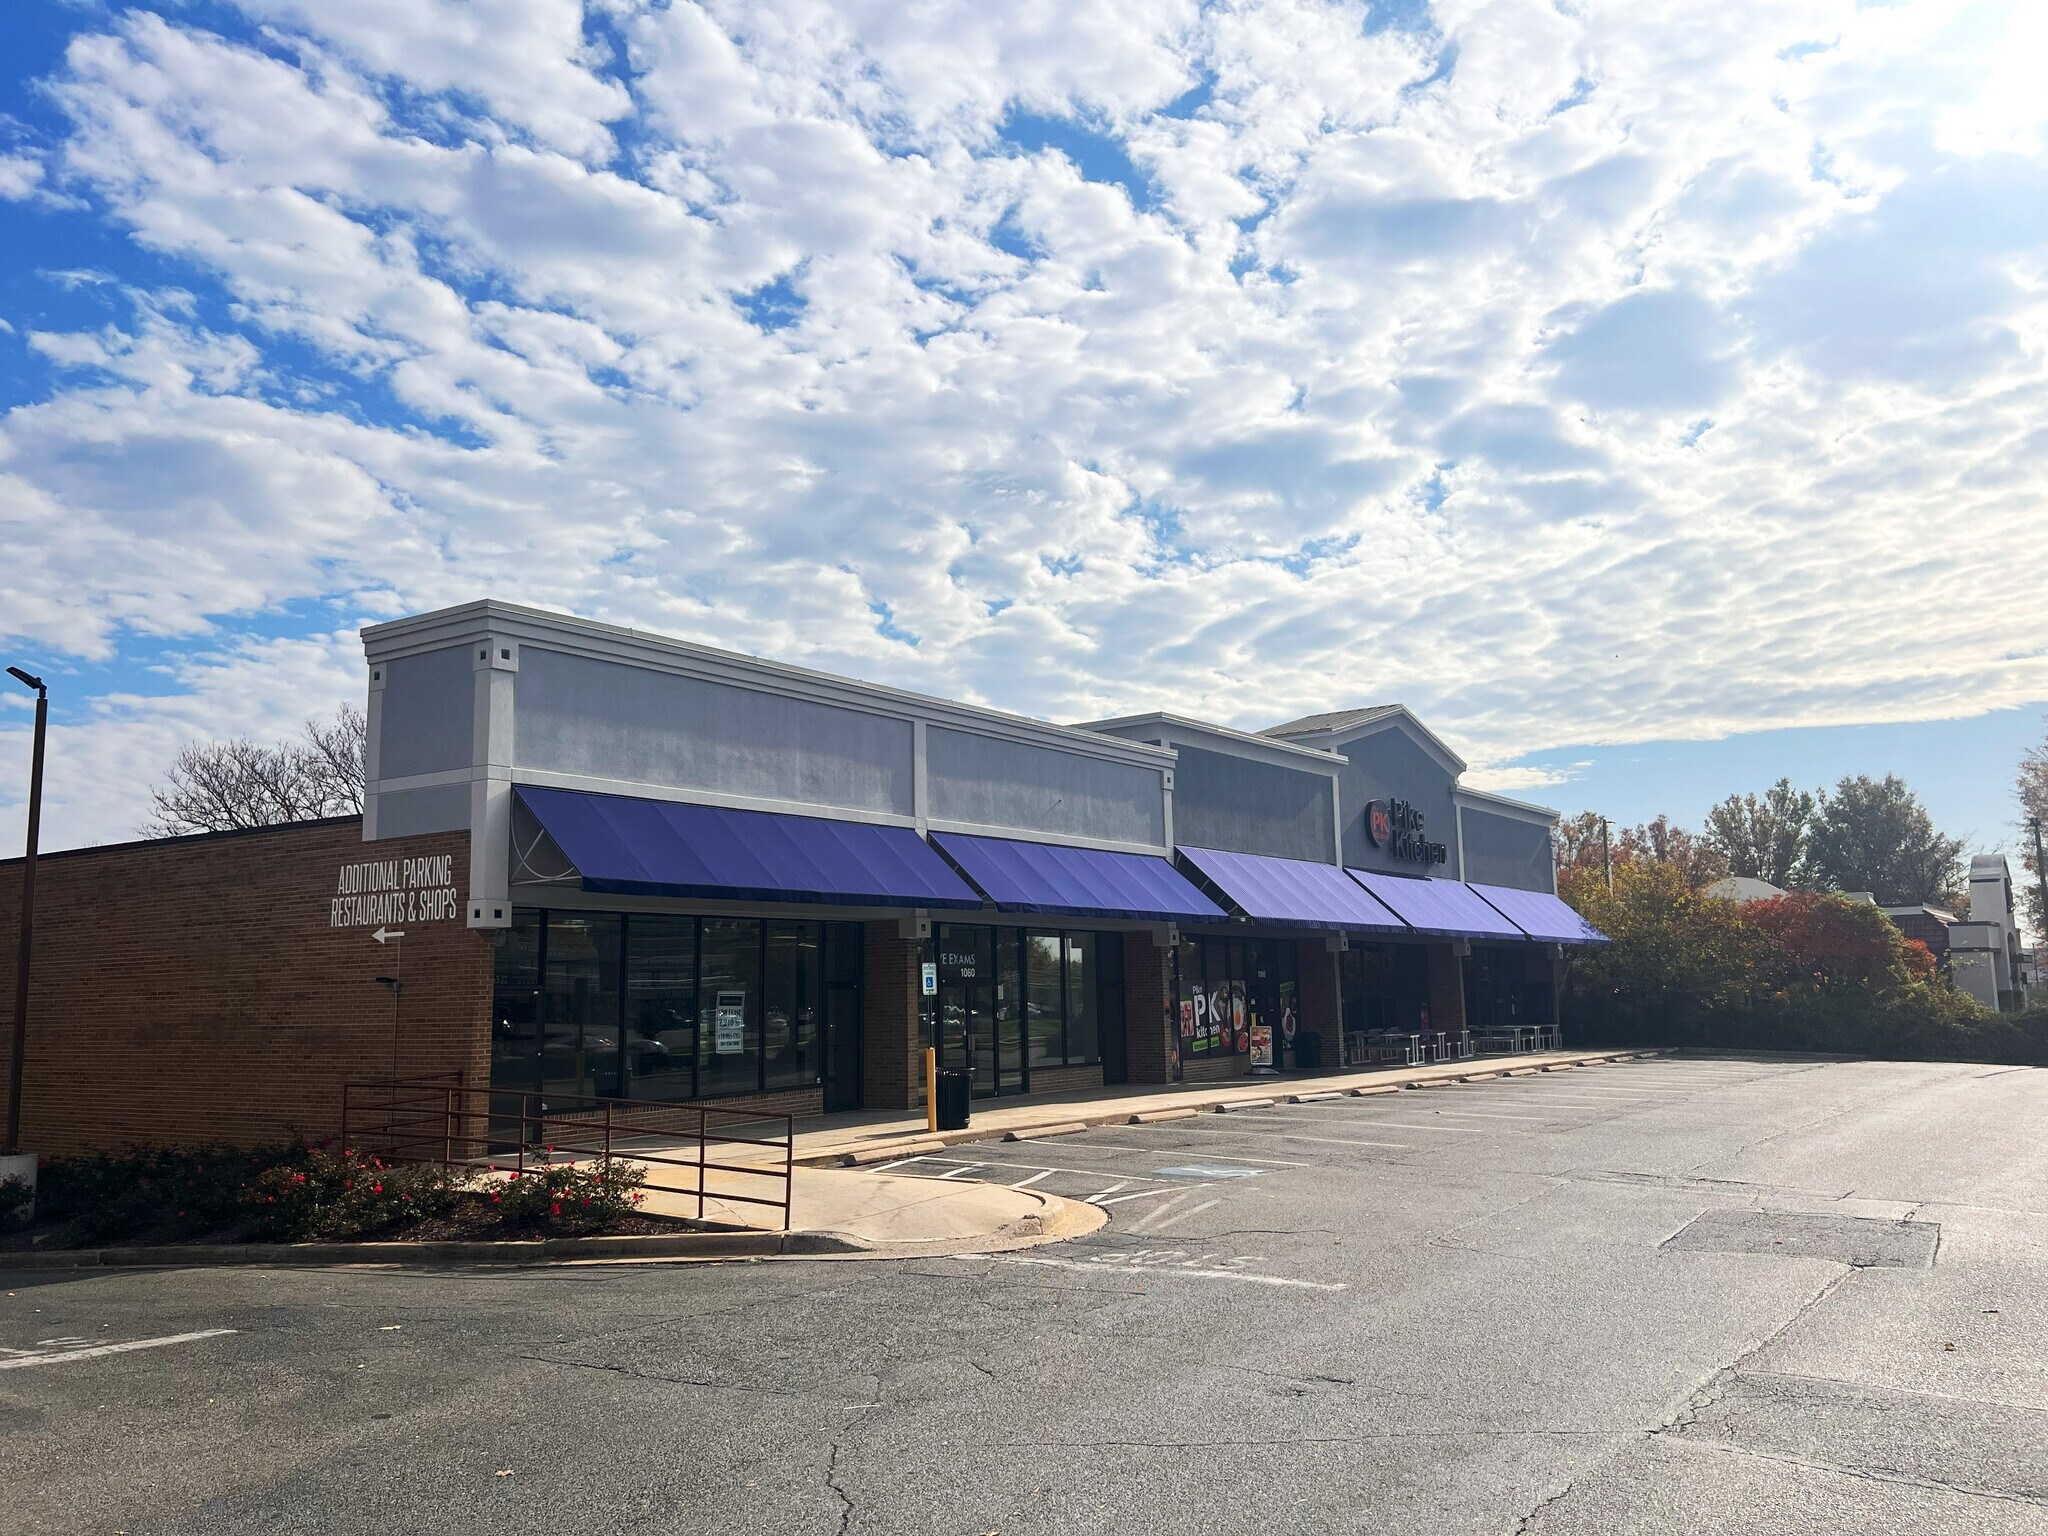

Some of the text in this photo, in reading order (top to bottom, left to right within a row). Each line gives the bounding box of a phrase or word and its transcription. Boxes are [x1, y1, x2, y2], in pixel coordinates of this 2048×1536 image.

[1373, 811, 1389, 833] PK
[1390, 798, 1425, 832] Pike
[1391, 829, 1447, 864] Kitchen
[337, 854, 452, 895] ADDITIONAL PARKING
[330, 887, 457, 928] RESTAURANTS & SHOPS
[948, 953, 976, 965] EXAMS
[960, 967, 976, 978] 1060
[1193, 990, 1221, 1027] PK
